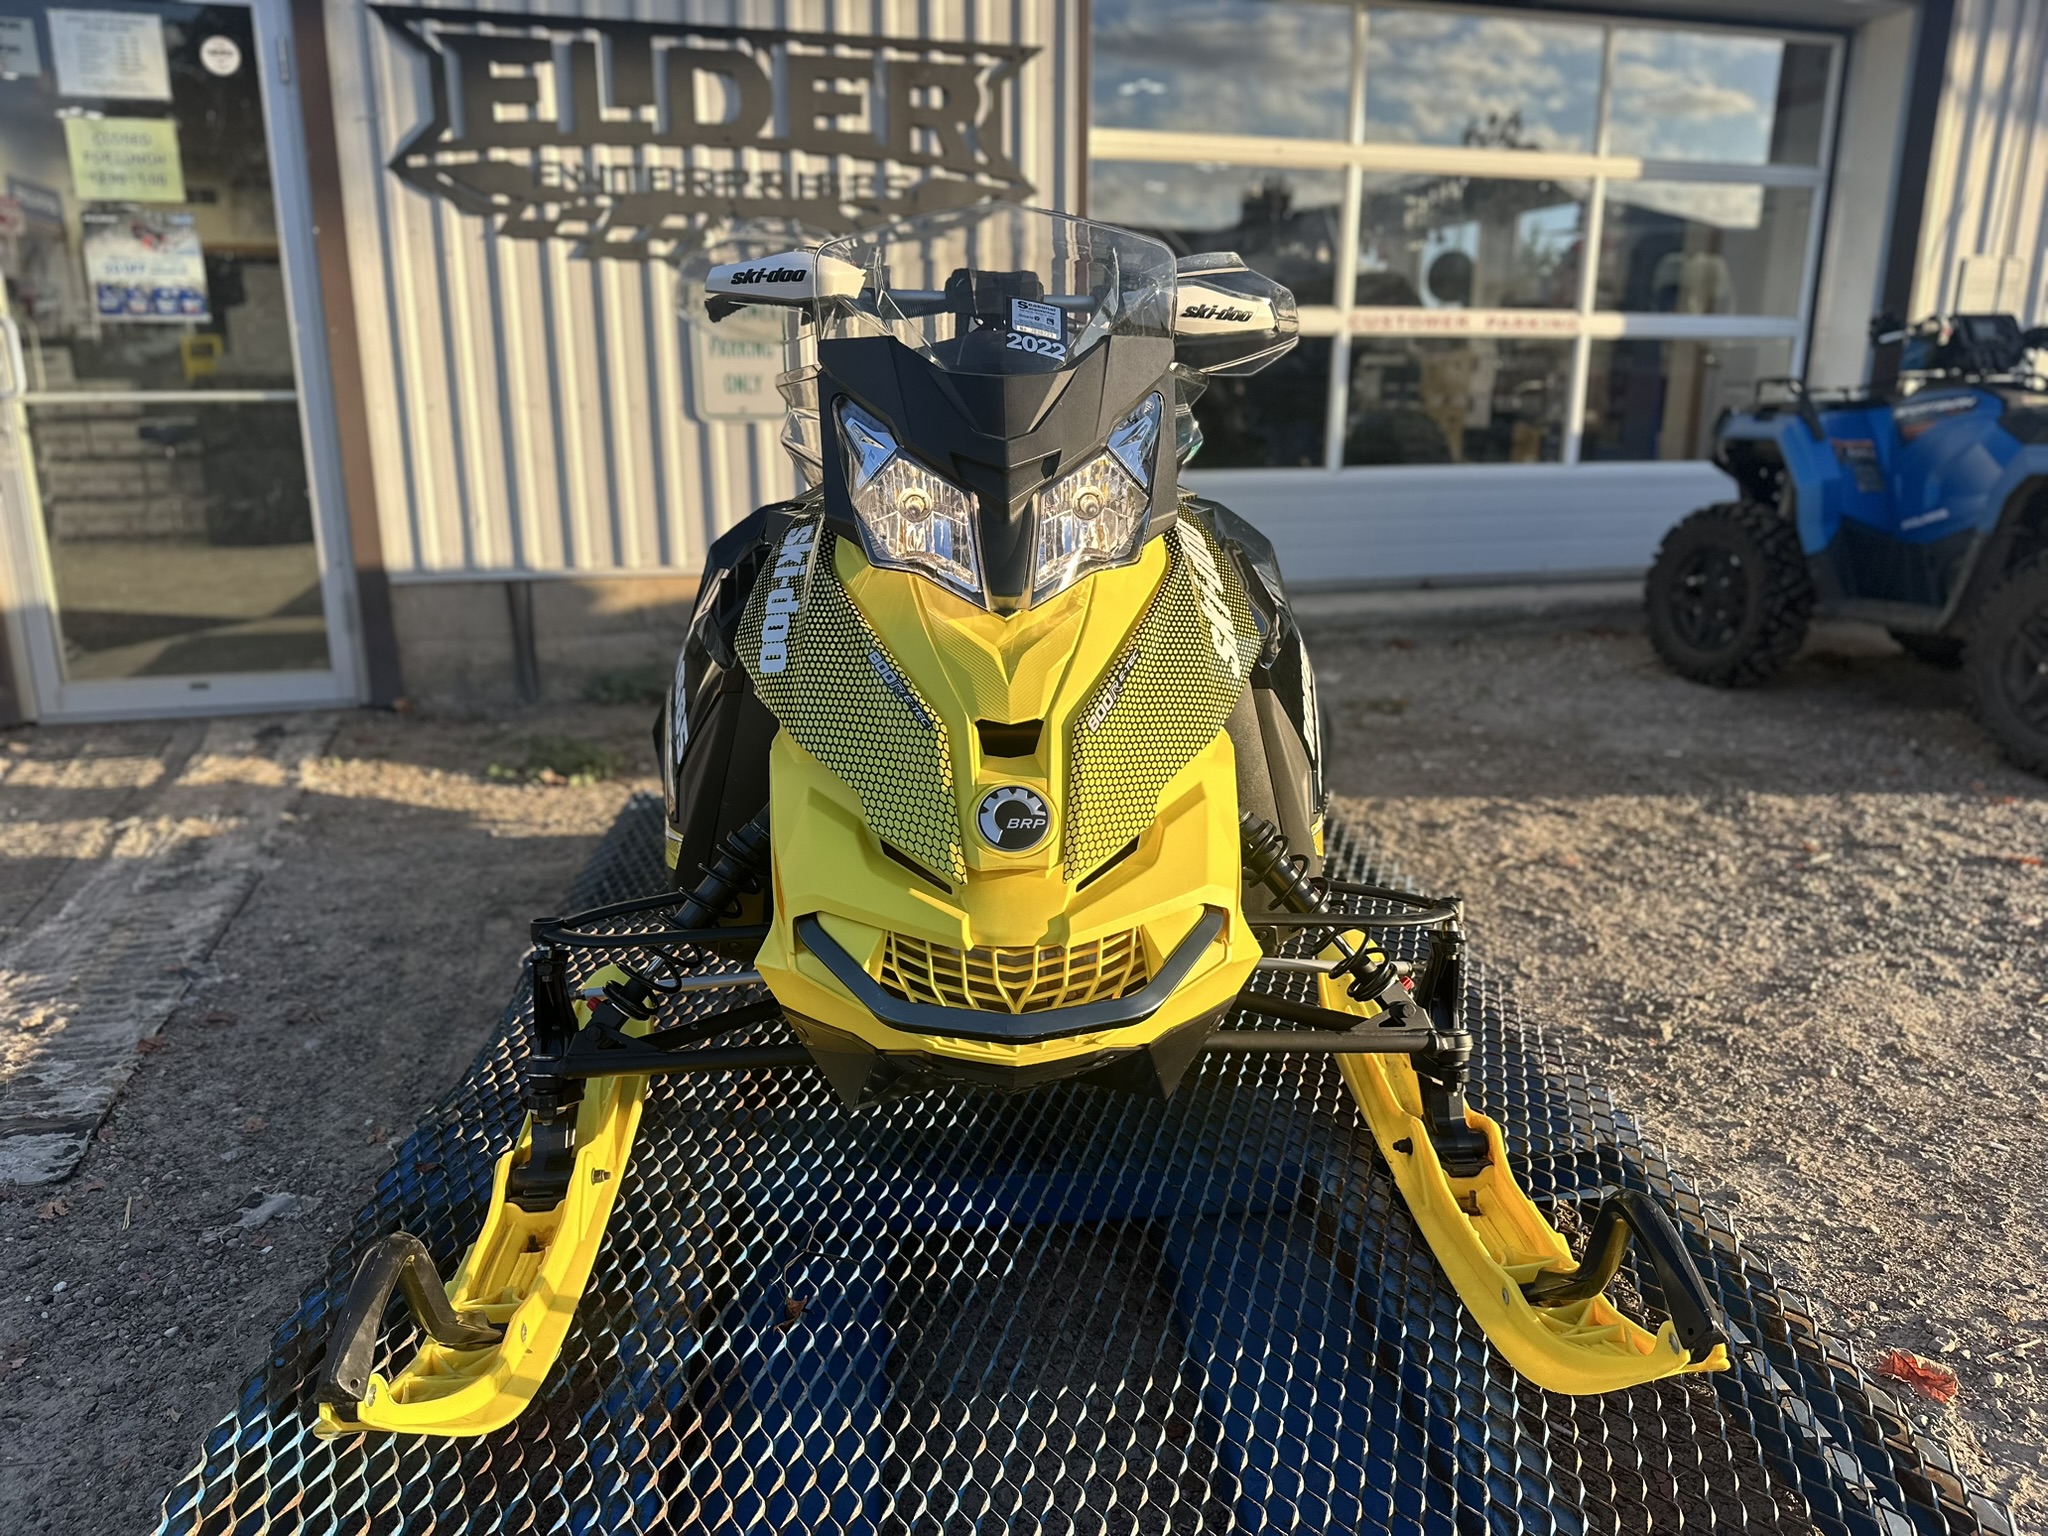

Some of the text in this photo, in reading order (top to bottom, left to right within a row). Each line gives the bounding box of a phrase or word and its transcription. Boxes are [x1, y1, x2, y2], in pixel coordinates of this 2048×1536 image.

[452, 28, 988, 164] ELDER
[730, 267, 808, 286] ski-doo
[1180, 303, 1254, 322] ski-doo
[1006, 332, 1067, 362] 2022
[722, 371, 764, 396] ONLY
[1006, 818, 1046, 830] BRP
